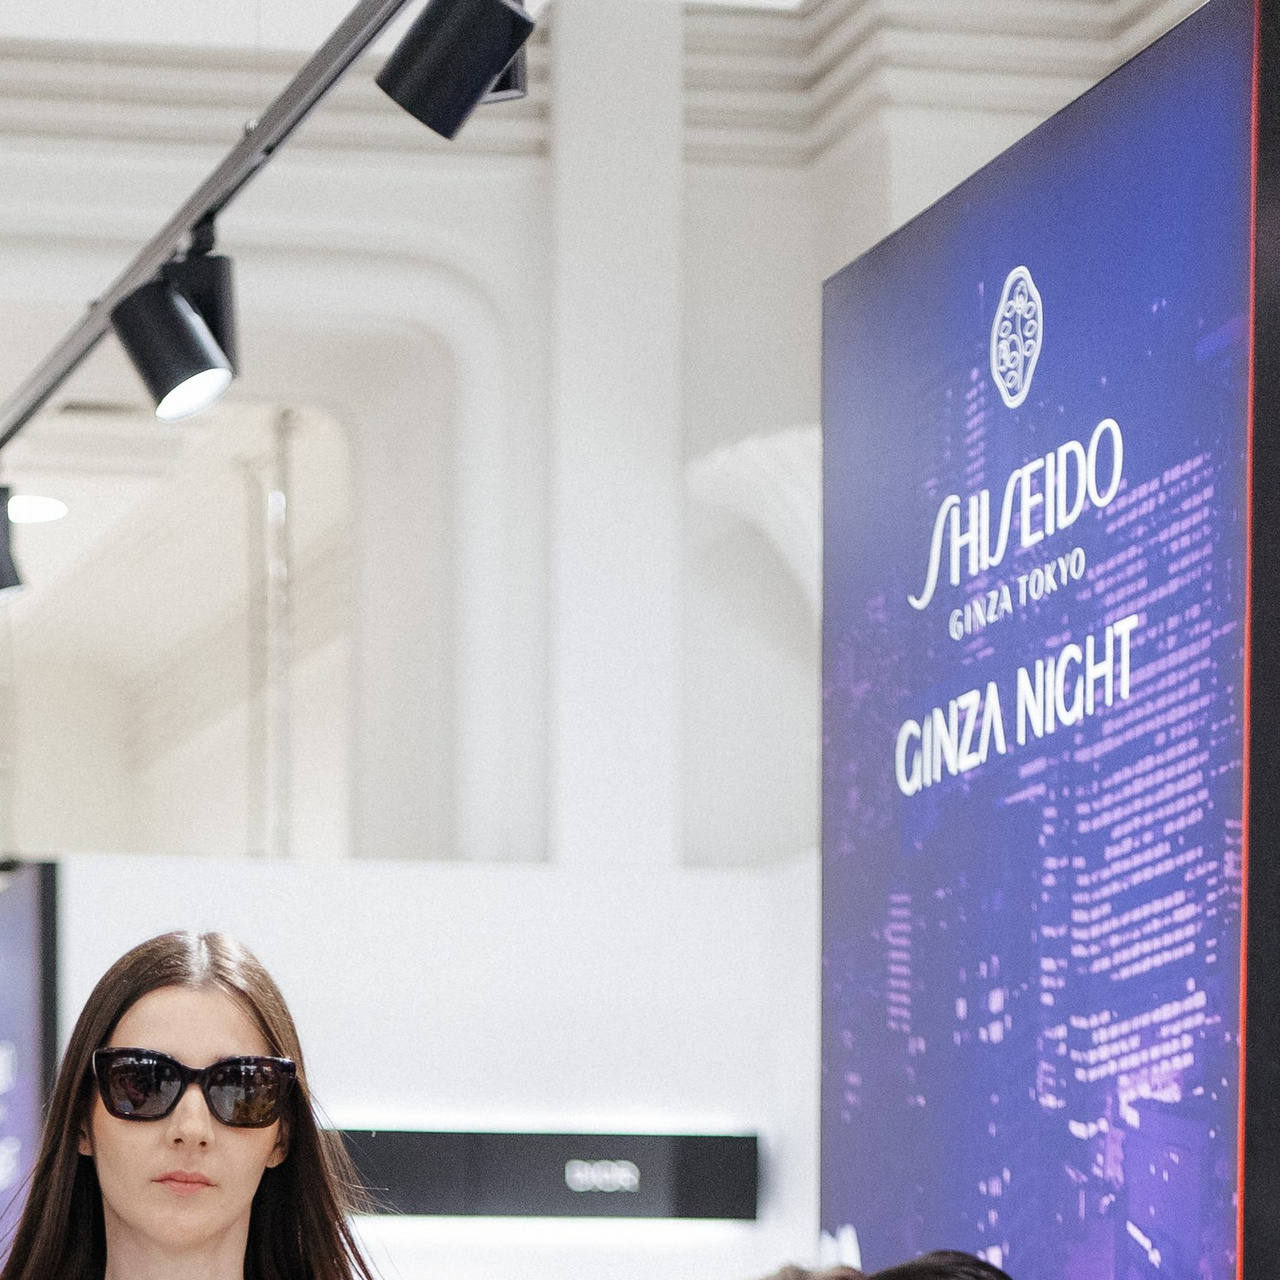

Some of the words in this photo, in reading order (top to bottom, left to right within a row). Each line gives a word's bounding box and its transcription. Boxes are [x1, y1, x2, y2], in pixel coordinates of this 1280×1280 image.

[907, 418, 1124, 610] SHISEIDO
[948, 584, 1014, 641] GINZA
[1016, 547, 1086, 607] TOKYO
[895, 681, 1007, 796] GINZA
[1017, 614, 1139, 746] NIGHT
